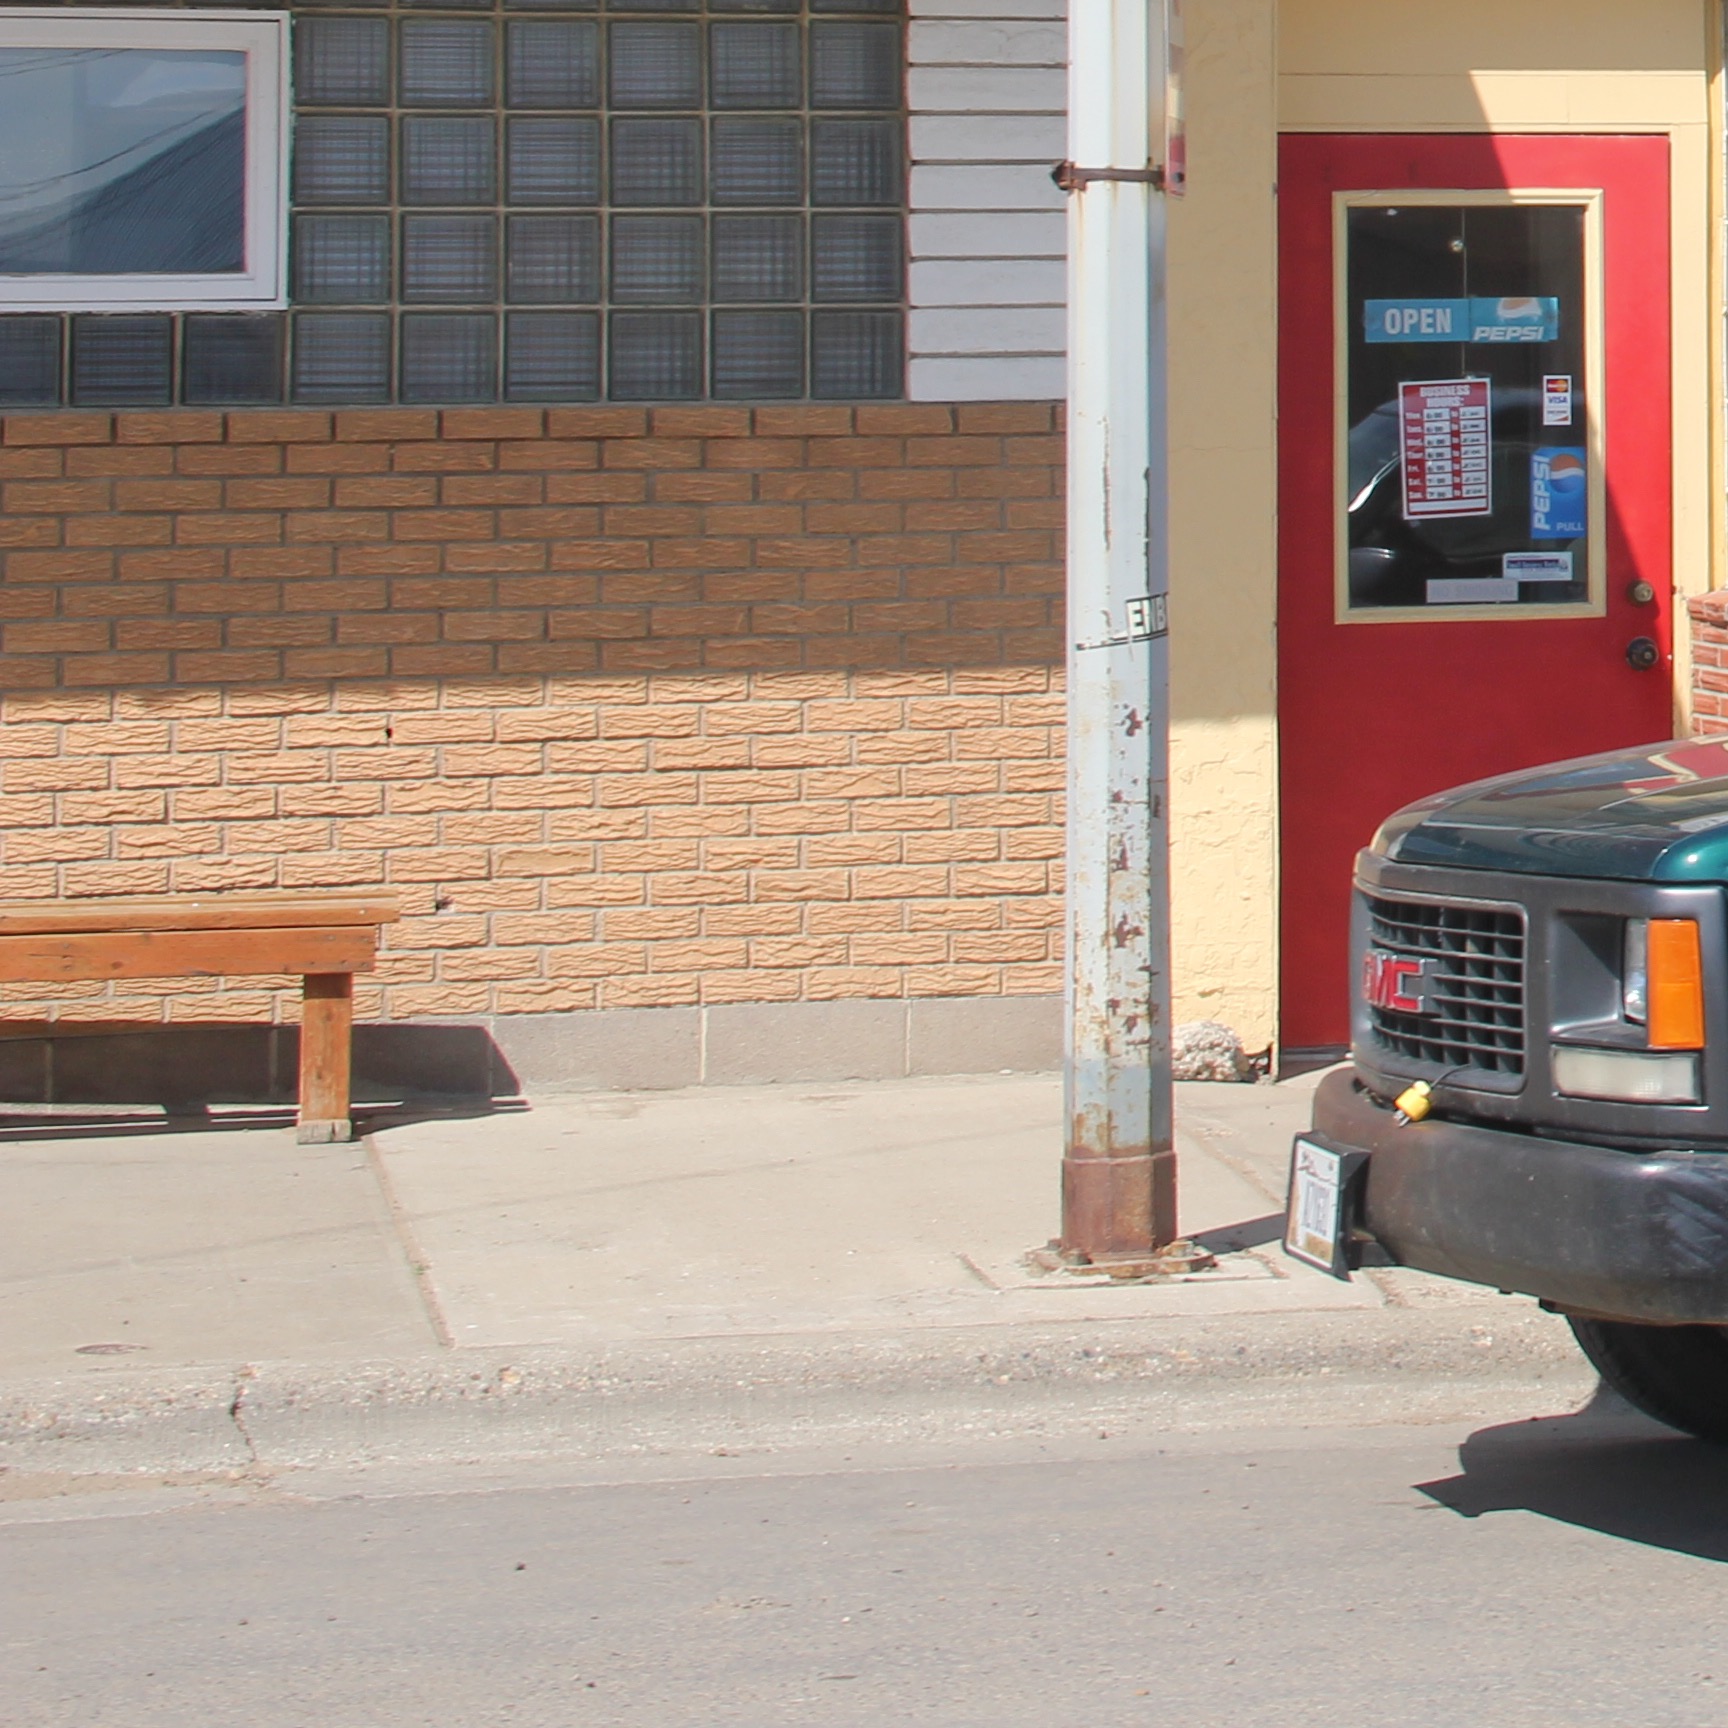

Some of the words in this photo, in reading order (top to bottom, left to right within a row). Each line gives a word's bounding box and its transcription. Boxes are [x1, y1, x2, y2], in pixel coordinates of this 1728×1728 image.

[1384, 307, 1452, 335] OPEN
[1473, 325, 1545, 341] PEPSI
[1533, 454, 1551, 532] PEPSI
[1556, 521, 1584, 532] PULL
